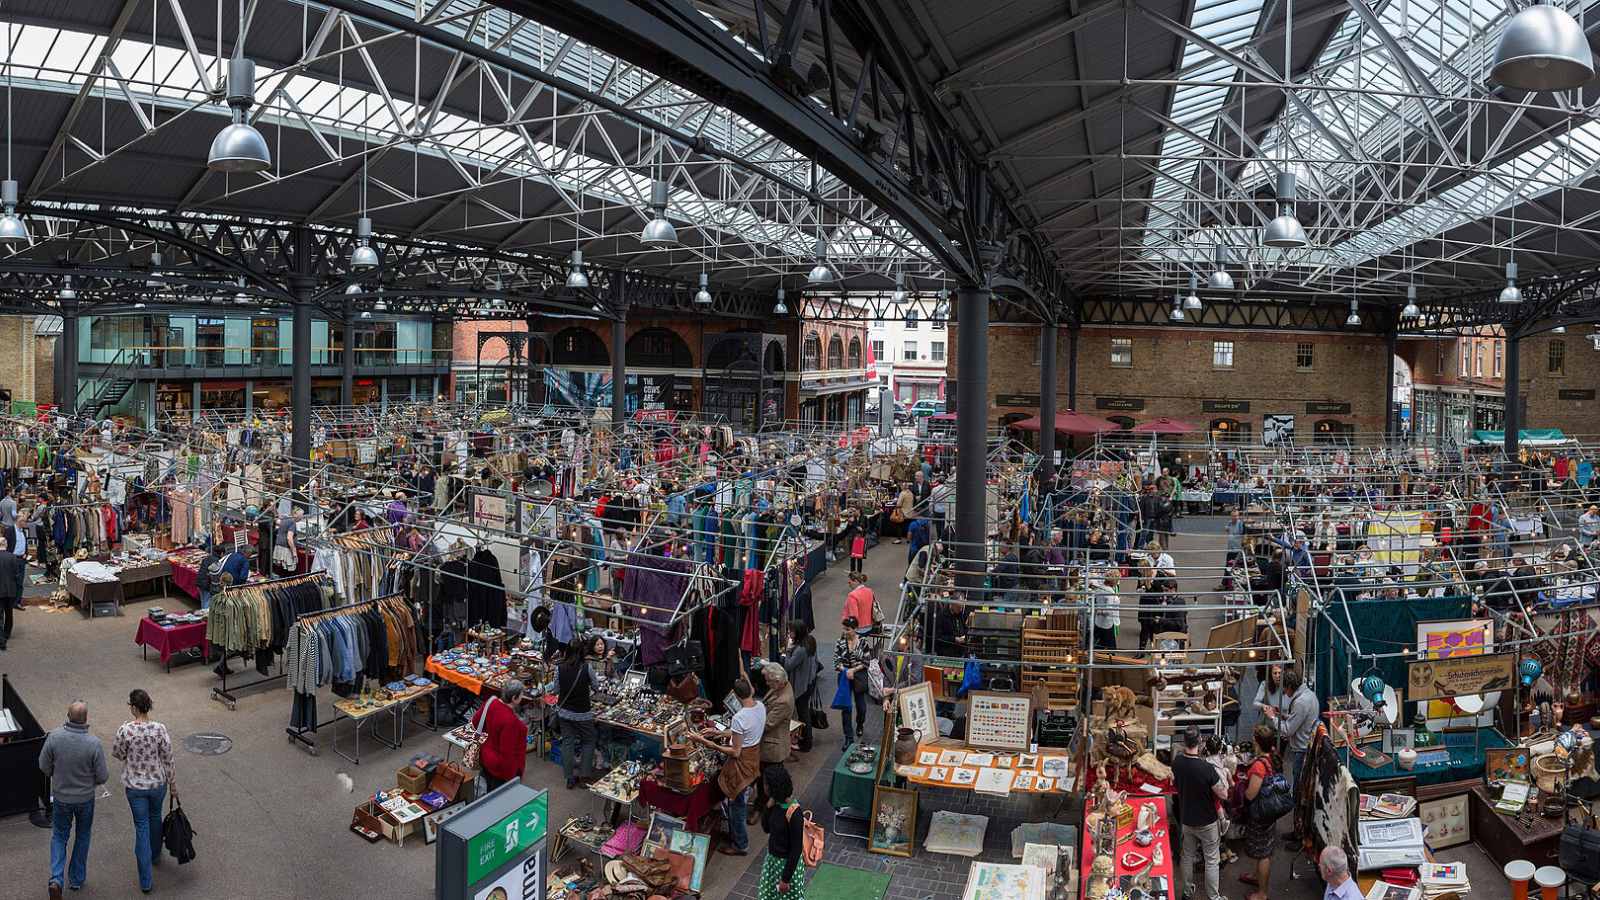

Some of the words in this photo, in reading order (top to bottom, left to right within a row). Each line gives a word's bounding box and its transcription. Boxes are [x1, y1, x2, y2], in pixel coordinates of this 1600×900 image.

[1445, 735, 1473, 744] LADIES
[1418, 753, 1445, 762] GENTS
[480, 839, 496, 855] FIRE
[480, 849, 496, 866] EXIT
